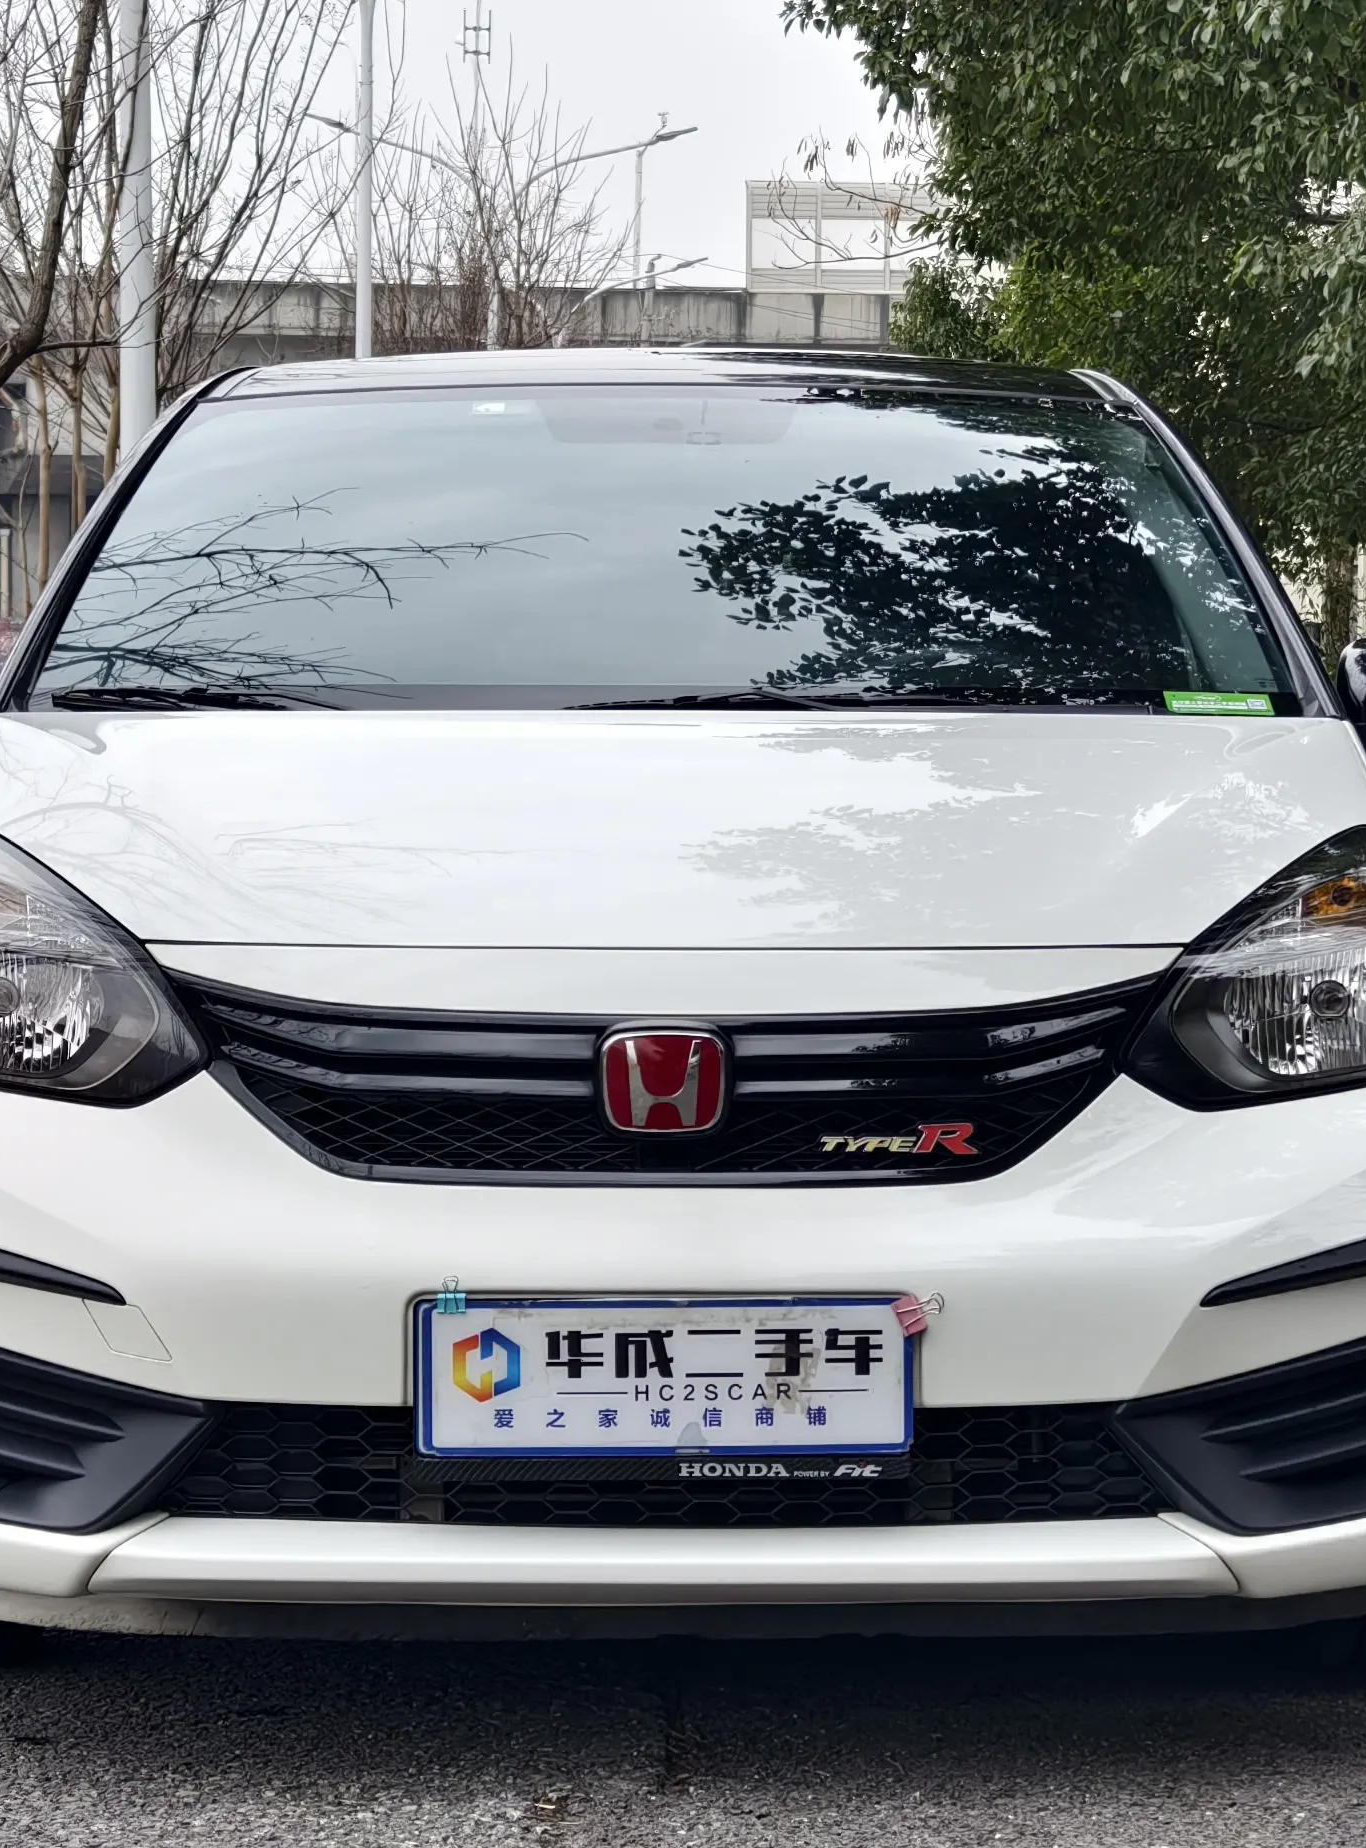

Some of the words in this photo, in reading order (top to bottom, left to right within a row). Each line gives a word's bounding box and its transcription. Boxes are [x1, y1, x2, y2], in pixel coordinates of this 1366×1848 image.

[820, 1136, 917, 1153] TYPE
[913, 1123, 978, 1154] R
[545, 1328, 883, 1378] 华成二手车
[635, 1384, 791, 1401] HC2SCAR
[493, 1407, 827, 1428] 爱之家诚信商铺
[678, 1463, 789, 1477] HONDA
[793, 1470, 818, 1478] POWER
[819, 1470, 830, 1478] BY
